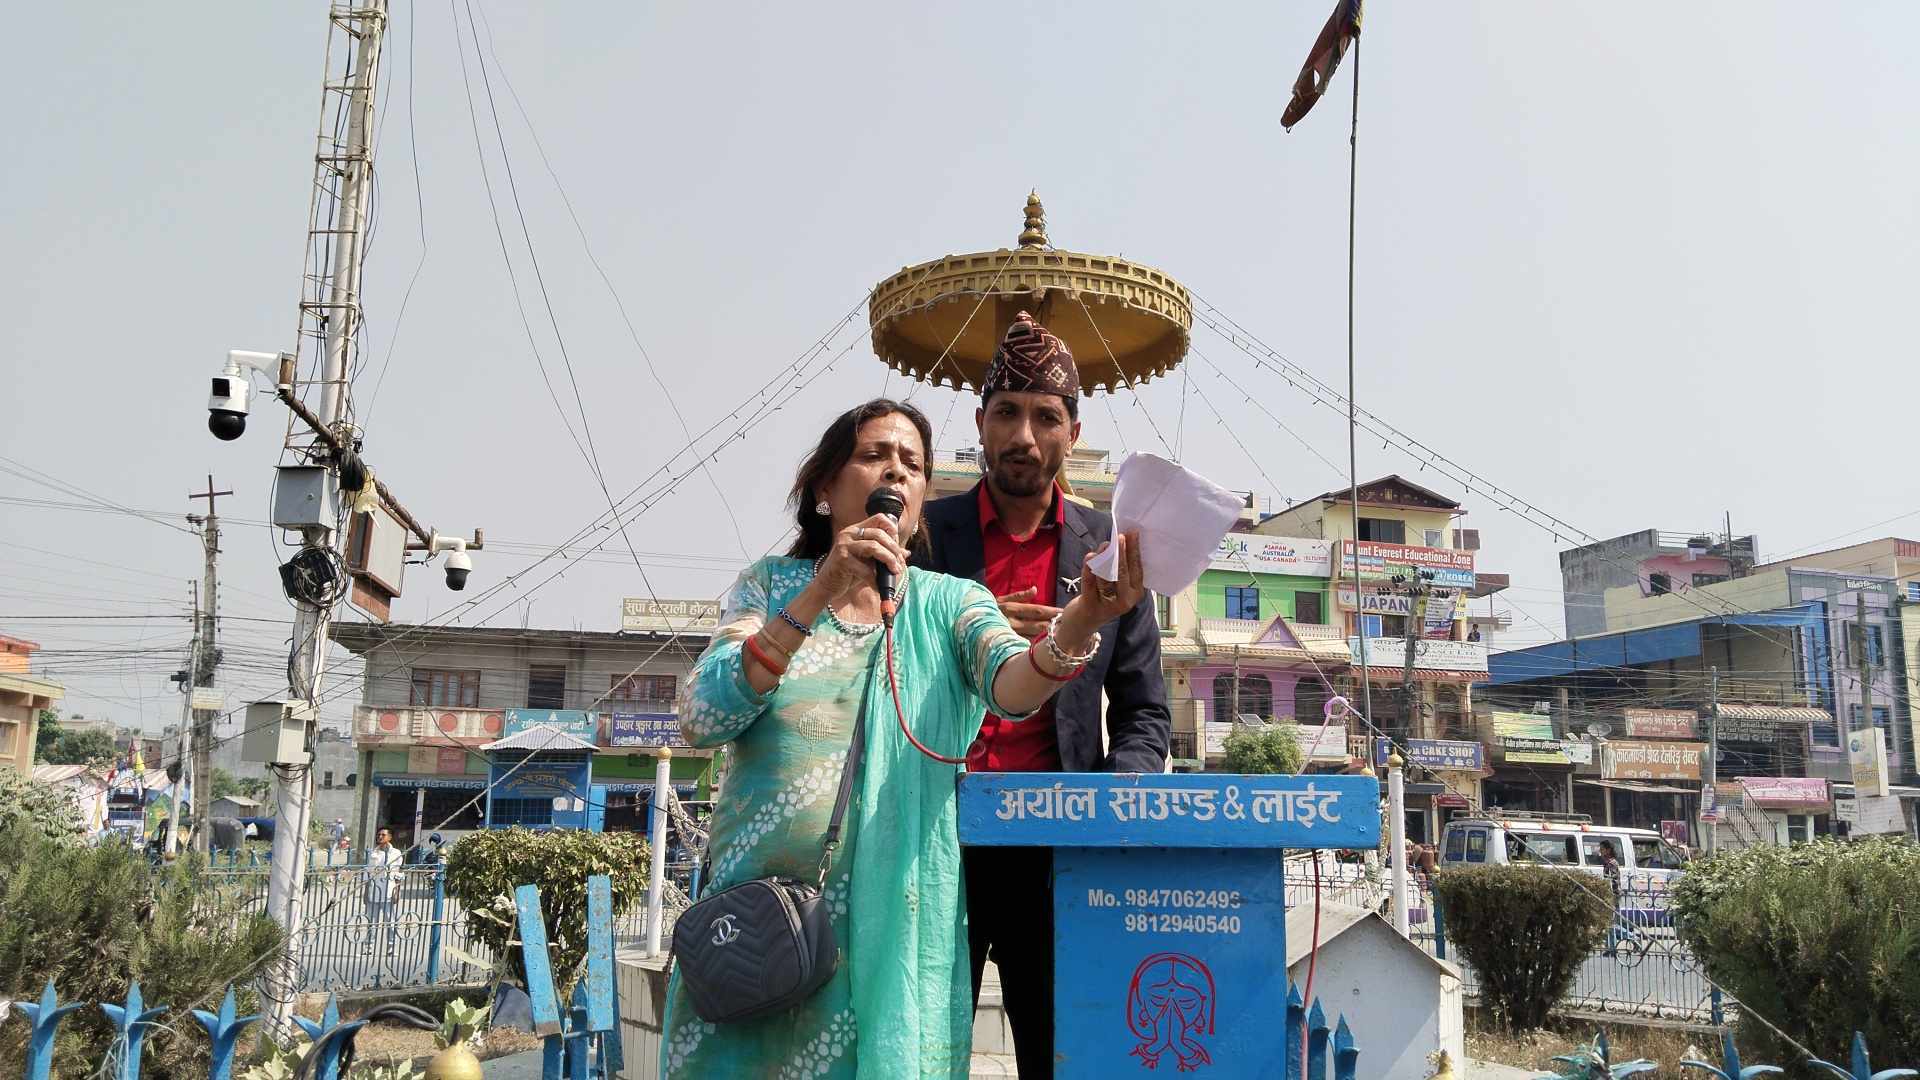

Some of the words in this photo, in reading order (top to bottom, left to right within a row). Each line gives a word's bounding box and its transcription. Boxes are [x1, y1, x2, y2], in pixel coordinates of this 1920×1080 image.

[1346, 543, 1371, 555] Munt
[1374, 545, 1402, 558] Everest
[1405, 548, 1450, 563] Educational
[1453, 553, 1471, 565] Zone
[1361, 596, 1409, 612] JAPAN
[1422, 745, 1447, 757] CAKE
[1448, 746, 1475, 758] SHOP
[995, 782, 1098, 821] अर्याल
[1109, 787, 1219, 821] साउण्ड
[1223, 785, 1246, 820] &
[1251, 782, 1343, 828] लाईट
[1088, 889, 1121, 907] Mo.
[1125, 915, 1241, 934] 9812940540
